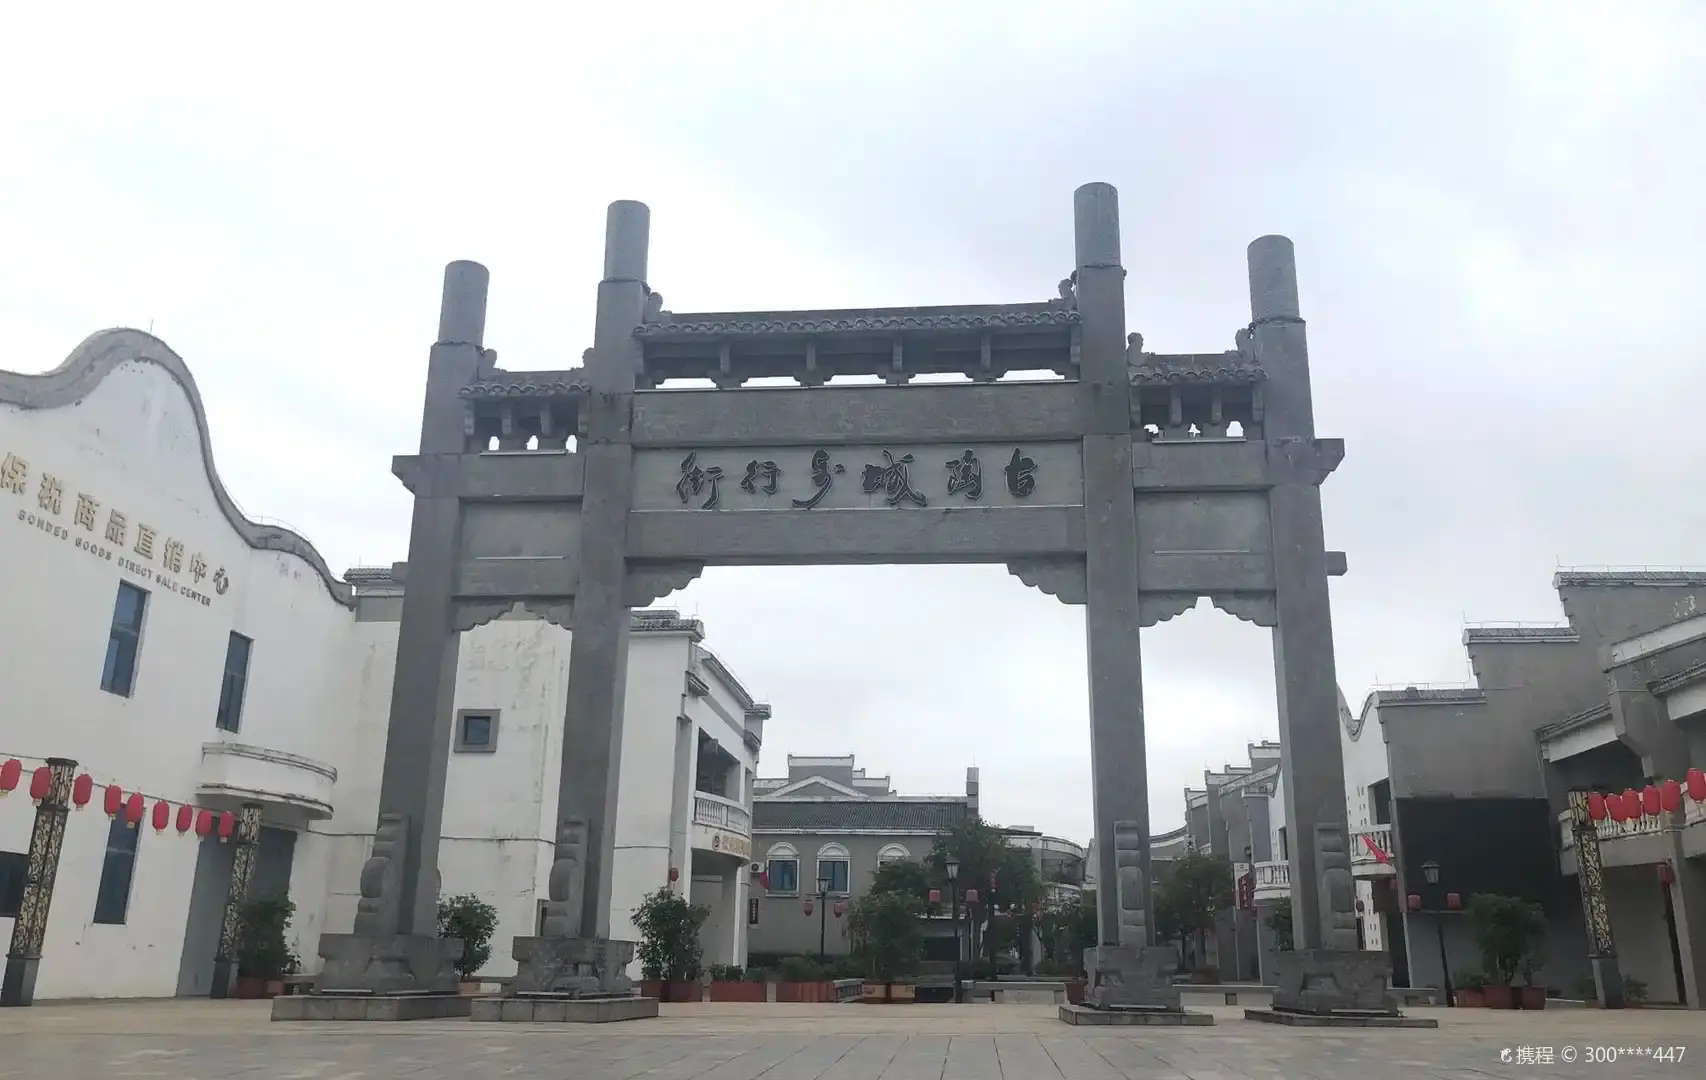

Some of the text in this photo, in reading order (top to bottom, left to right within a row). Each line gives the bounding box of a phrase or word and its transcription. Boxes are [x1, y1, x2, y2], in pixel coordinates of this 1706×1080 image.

[0, 452, 230, 595] 保税商品直销中心
[17, 509, 212, 607] BONDED GOODS DIRECT SALE CENTER
